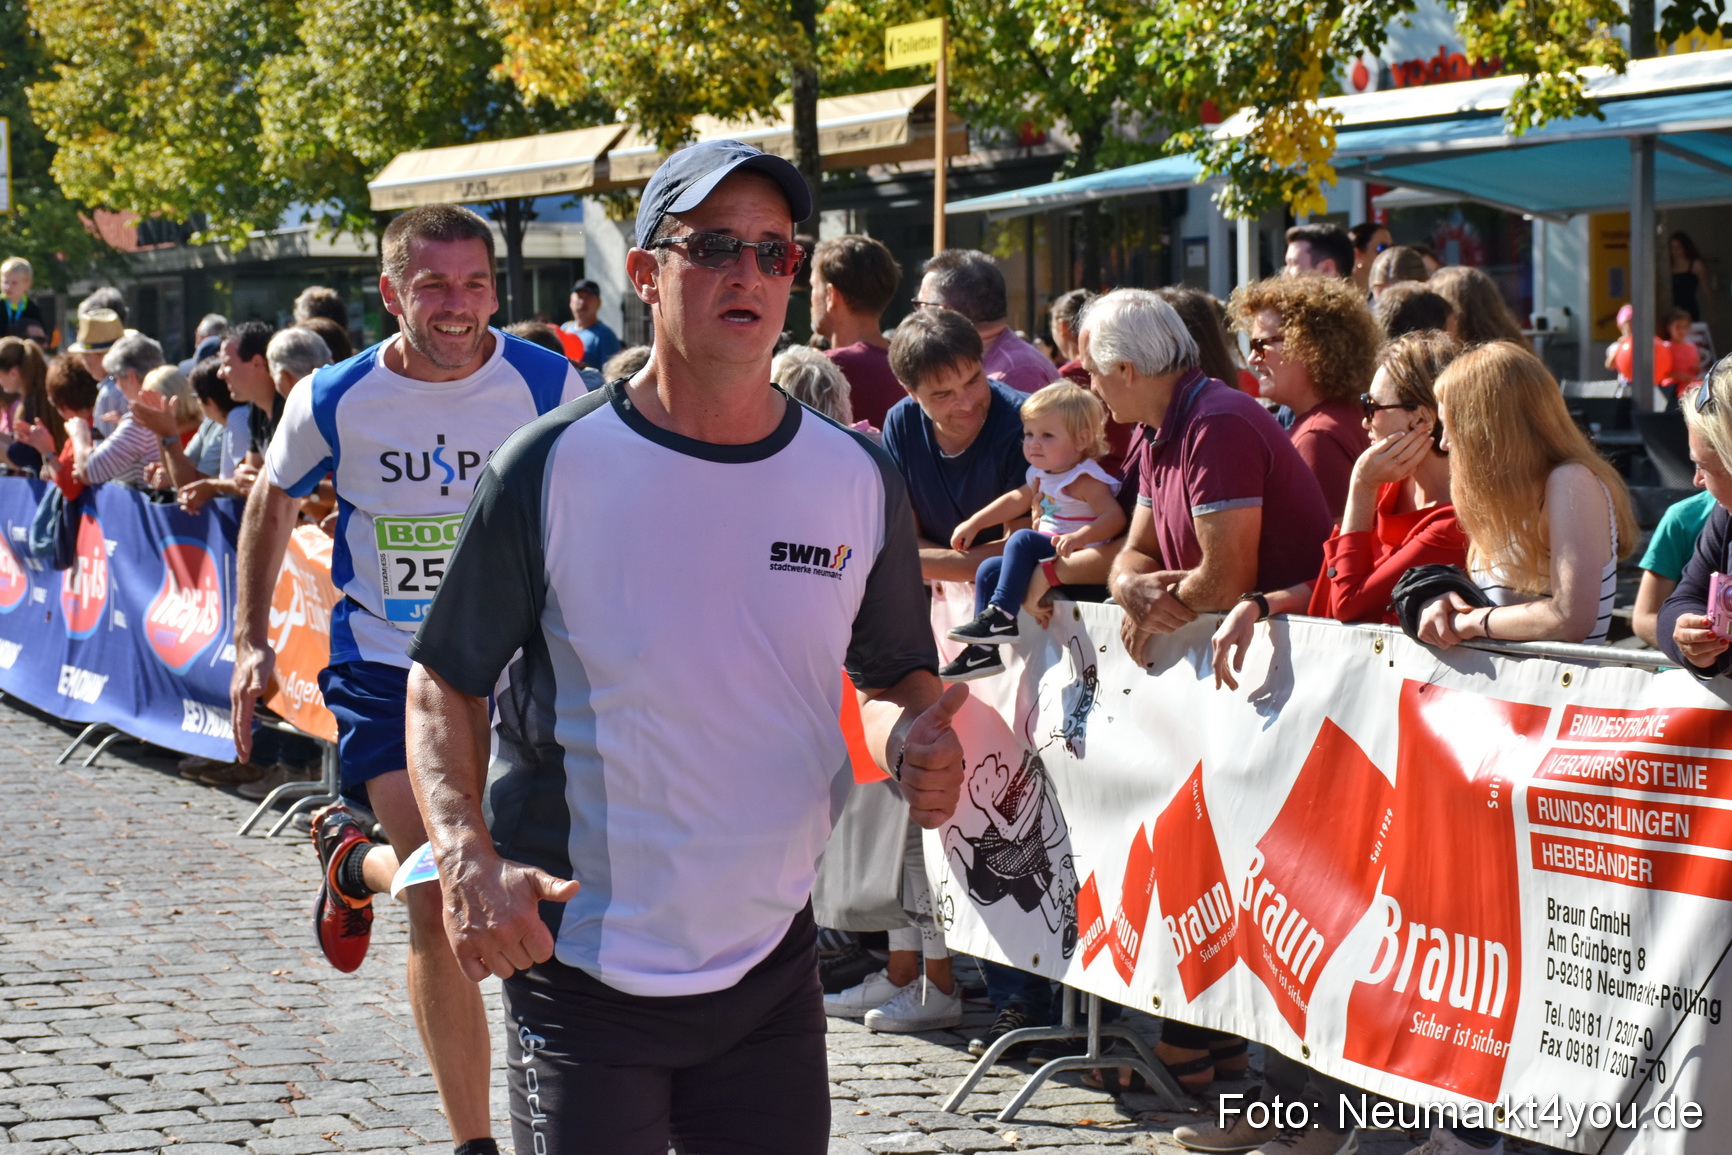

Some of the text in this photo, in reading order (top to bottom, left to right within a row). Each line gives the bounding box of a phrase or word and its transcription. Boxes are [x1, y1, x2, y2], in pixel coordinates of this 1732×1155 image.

[897, 35, 938, 55] Toiletten
[380, 436, 486, 495] SUSP
[769, 562, 812, 574] stadtwerke
[770, 541, 831, 568] swn
[1569, 713, 1670, 738] BINDESTRICKE
[1487, 776, 1502, 809] Seit
[1547, 754, 1708, 790] VERZURRSYSTEME
[1370, 808, 1393, 864] Seit 1929
[1537, 796, 1690, 838] RUNDSCHLINGEN
[1542, 842, 1653, 883] HEBEBÄNDER
[1163, 881, 1232, 965] Braun
[1238, 845, 1325, 985] Braun
[1547, 897, 1631, 937] Braun GmbH
[1200, 943, 1221, 962] Sicher
[1219, 934, 1228, 947] ist
[1356, 891, 1508, 1018] Braun
[1547, 927, 1646, 975] Am Grünberg 8
[1262, 943, 1308, 1014] Sicher ist sicher
[1547, 957, 1722, 1025] D-92318 Neumarkt-Pölling
[1409, 1011, 1511, 1058] Sicher ist sicher
[1545, 1000, 1653, 1051] Tel. 09181 / 2307-0
[1539, 1030, 1666, 1084] Fax 09181 / 2307-70
